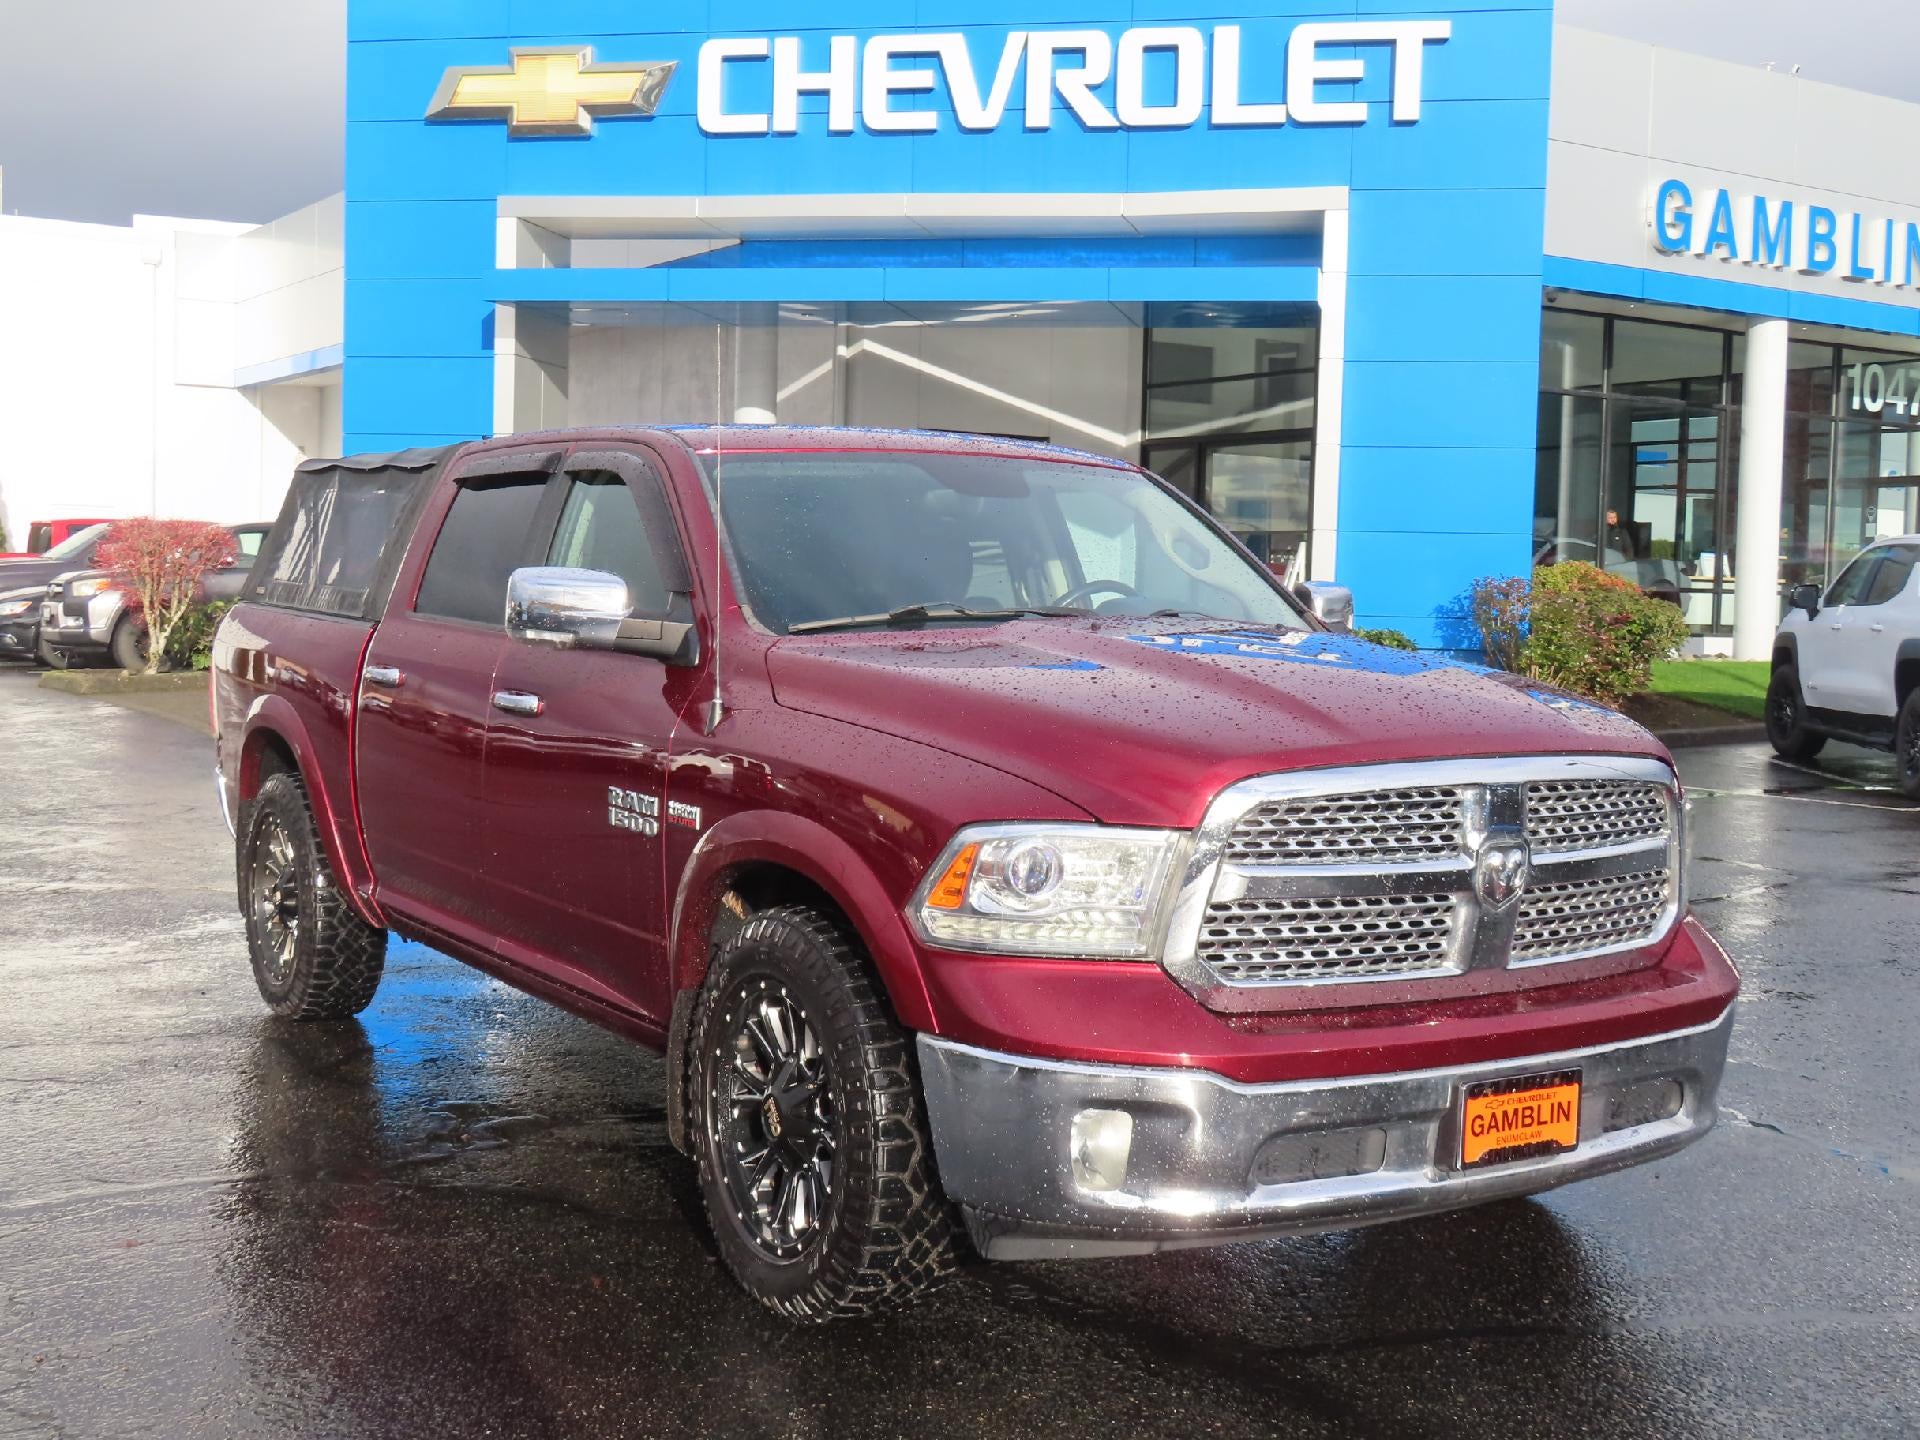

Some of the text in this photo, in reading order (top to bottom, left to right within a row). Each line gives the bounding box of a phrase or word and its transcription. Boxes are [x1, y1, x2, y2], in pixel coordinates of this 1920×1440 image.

[697, 19, 1452, 135] CHEVROLET
[608, 785, 659, 817] RAM
[608, 806, 660, 837] 1500
[1506, 1091, 1558, 1105] CHEVROLET
[1470, 1101, 1572, 1137] GAMBLIN
[1496, 1130, 1542, 1145] ENUMCLAW
